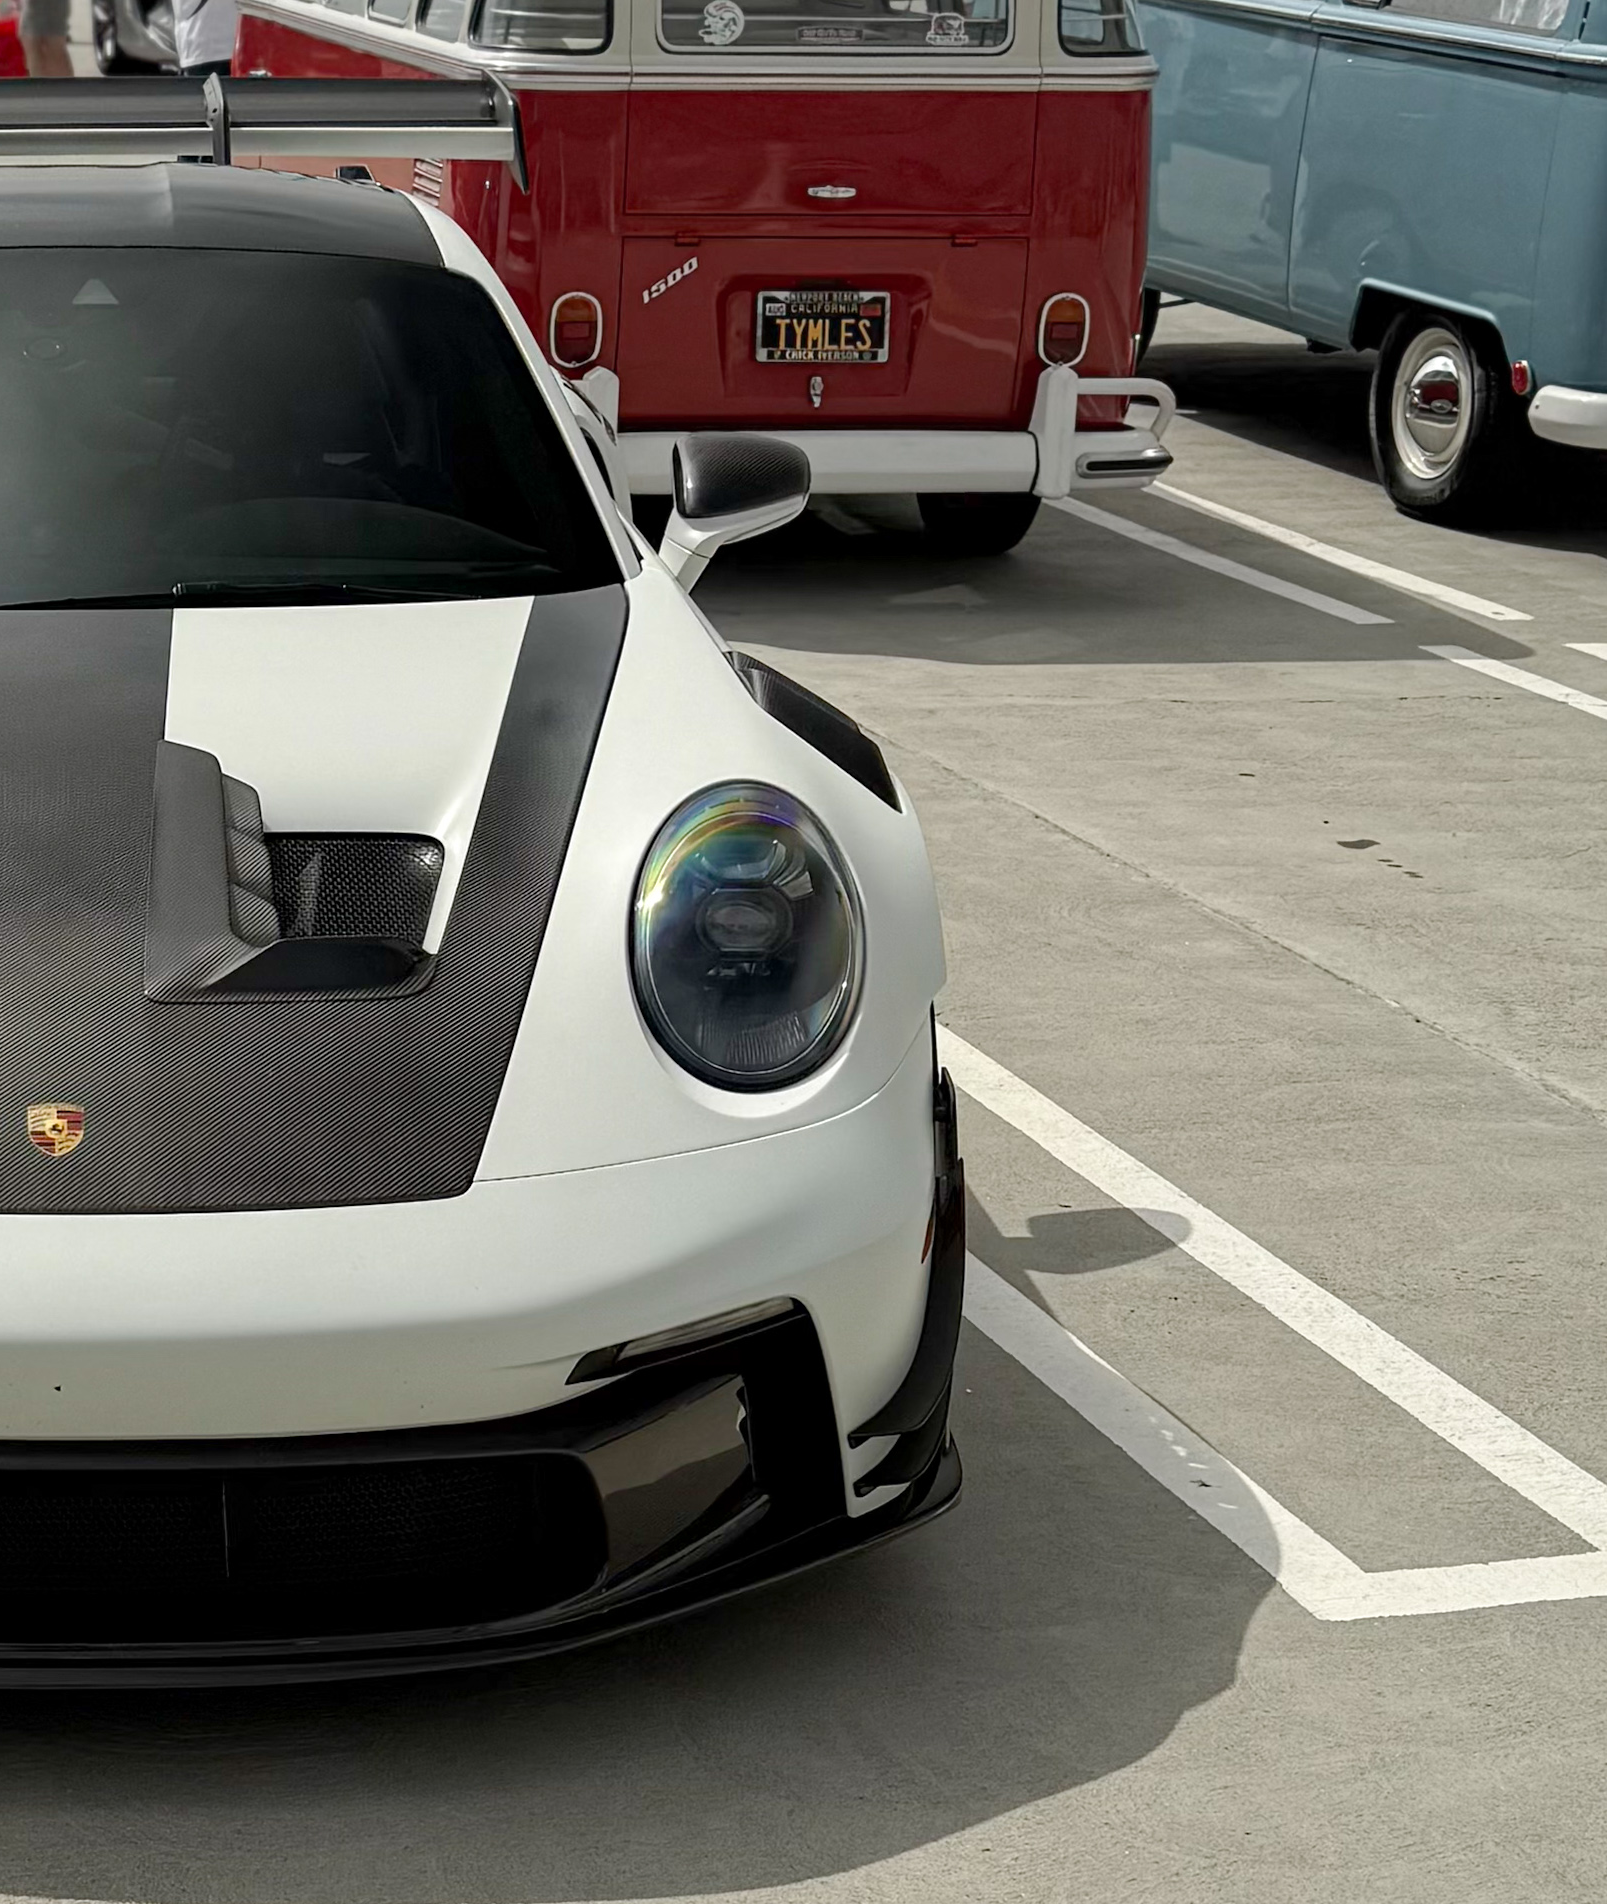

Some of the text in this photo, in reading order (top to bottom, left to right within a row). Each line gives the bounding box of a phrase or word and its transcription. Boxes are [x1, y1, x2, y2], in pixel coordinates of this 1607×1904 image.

[642, 256, 699, 305] 1500
[791, 303, 858, 314] CALIFORNIA
[775, 318, 872, 350] TYMLES
[785, 349, 860, 360] CHICK IVERSON
